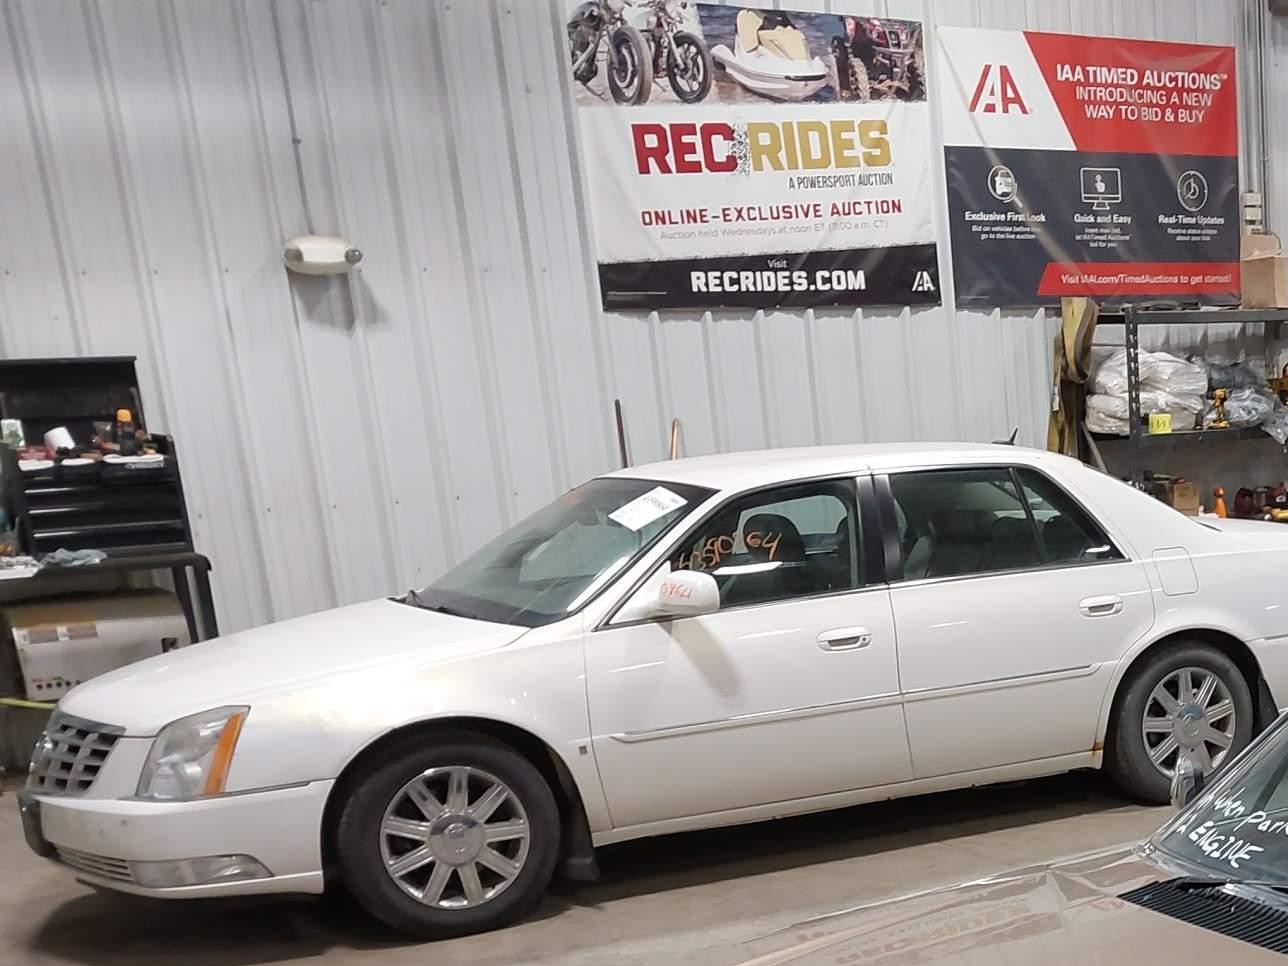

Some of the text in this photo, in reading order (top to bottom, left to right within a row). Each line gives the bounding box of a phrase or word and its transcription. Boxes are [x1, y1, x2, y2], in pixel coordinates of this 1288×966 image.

[1056, 64, 1084, 82] IAA
[1086, 66, 1138, 86] TIMED
[1076, 86, 1213, 106] INTRODUCING A NEW
[1085, 104, 1206, 123] WAY TO BID & BUY
[631, 119, 893, 175] REC RIDES
[788, 173, 893, 190] A POWERSPORT AUCTION
[641, 200, 903, 227] ONLINE-EXCLUSIVE AUCTION
[965, 210, 1006, 222] Exclusive
[1074, 213, 1132, 225] Quick and Easy
[1158, 215, 1196, 224] Real-Time
[660, 230, 697, 240] Auction
[767, 259, 788, 269] Visit
[690, 270, 866, 293] RECRIDES.COM
[1061, 274, 1079, 284] Visit
[1180, 274, 1188, 284] to
